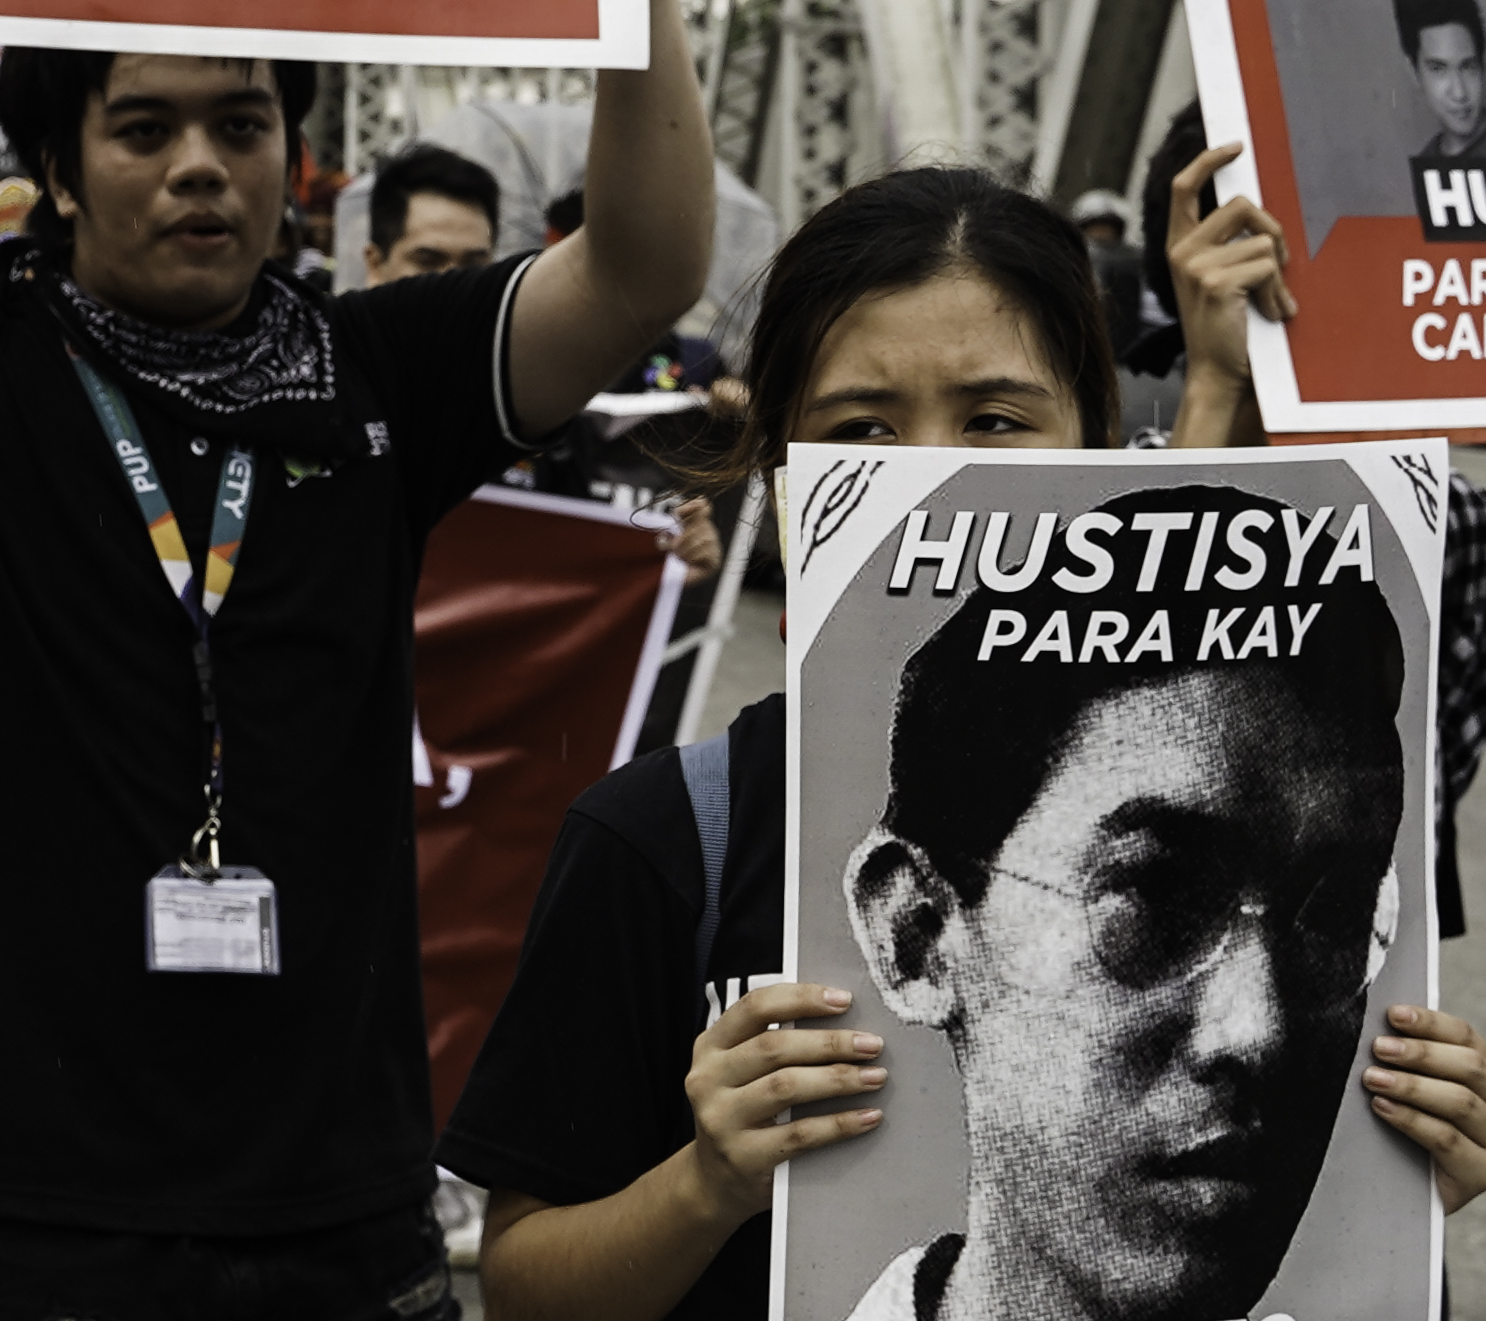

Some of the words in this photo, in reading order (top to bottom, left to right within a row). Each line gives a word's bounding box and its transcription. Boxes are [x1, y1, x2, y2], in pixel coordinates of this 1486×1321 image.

[115, 439, 159, 494] PUP
[886, 503, 1375, 594] HUSTISYA
[977, 608, 1174, 663] PARA
[1196, 602, 1323, 661] KAY
